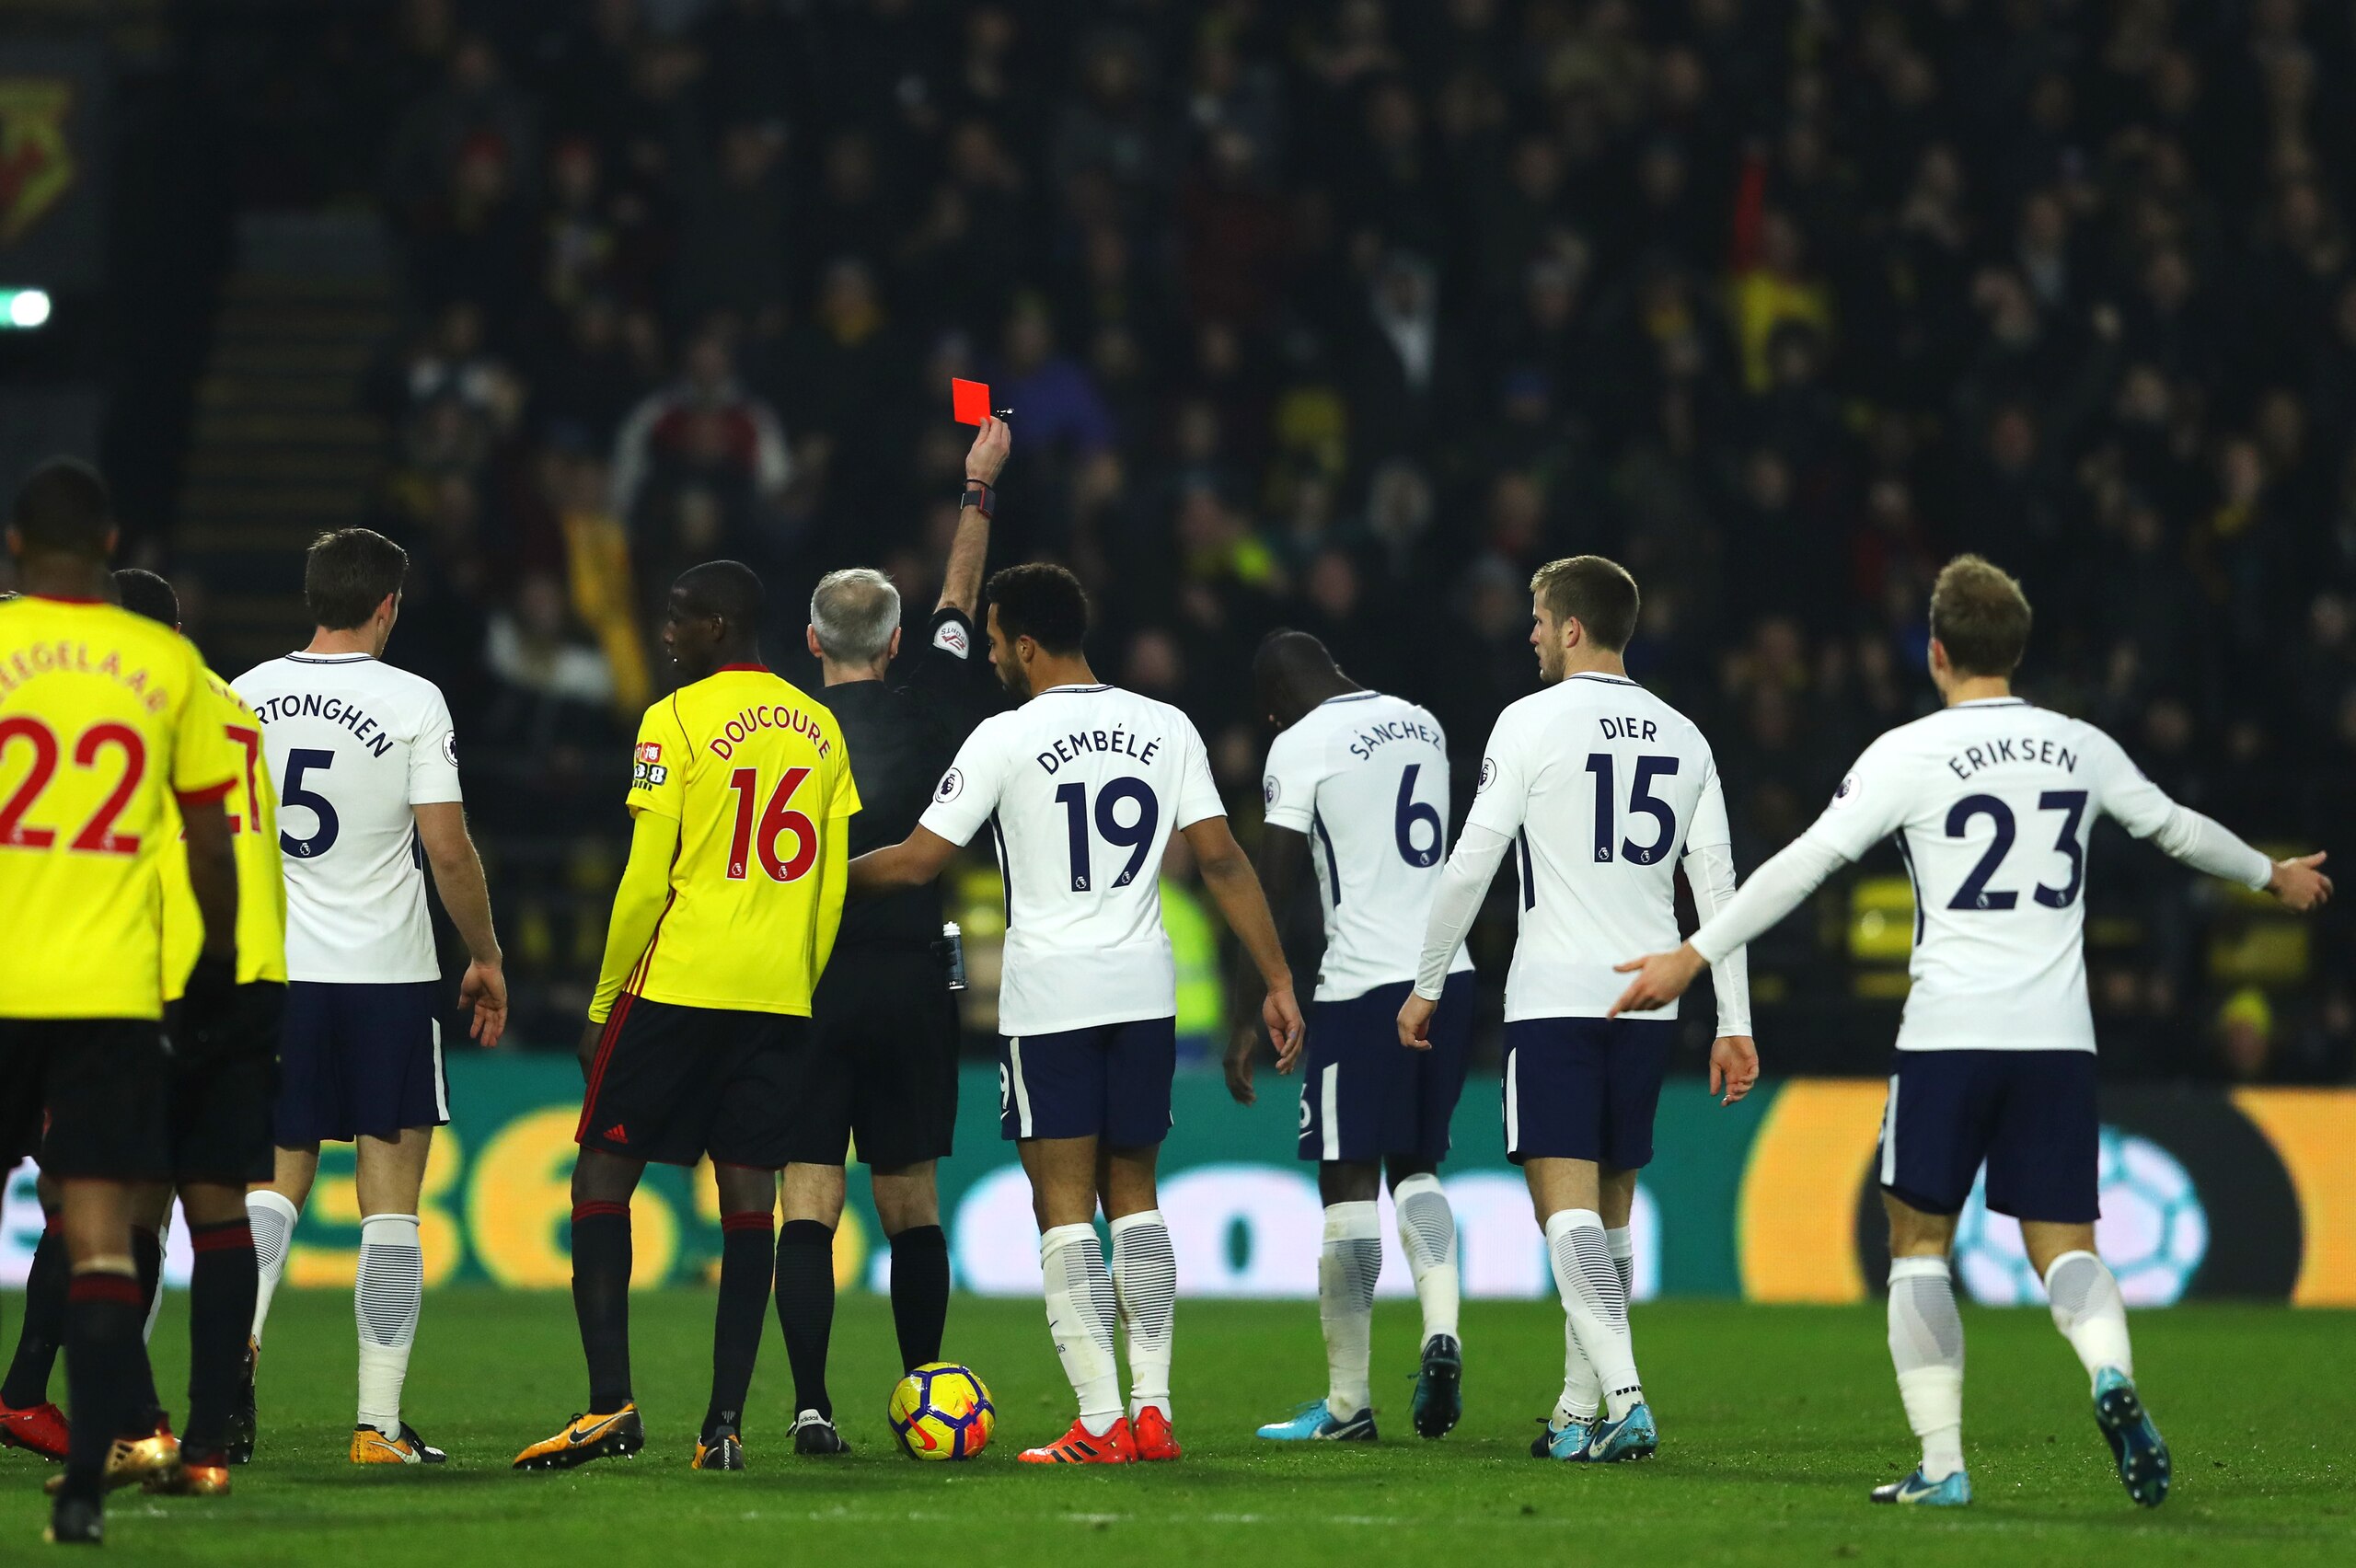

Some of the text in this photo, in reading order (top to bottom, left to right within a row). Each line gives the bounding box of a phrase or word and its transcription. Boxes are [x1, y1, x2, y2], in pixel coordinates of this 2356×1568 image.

[709, 706, 831, 761] DOUCOURE
[1036, 723, 1161, 775] DEMBÉLÉ
[1600, 717, 1657, 743] DIER
[1947, 738, 2078, 781] ERIKSEN
[0, 716, 145, 856] 22
[279, 748, 339, 859] 5
[726, 767, 817, 882] 16
[1055, 776, 1159, 892] 19
[1394, 763, 1442, 868] 6
[1585, 753, 1680, 866] 15
[1945, 790, 2088, 910] 23
